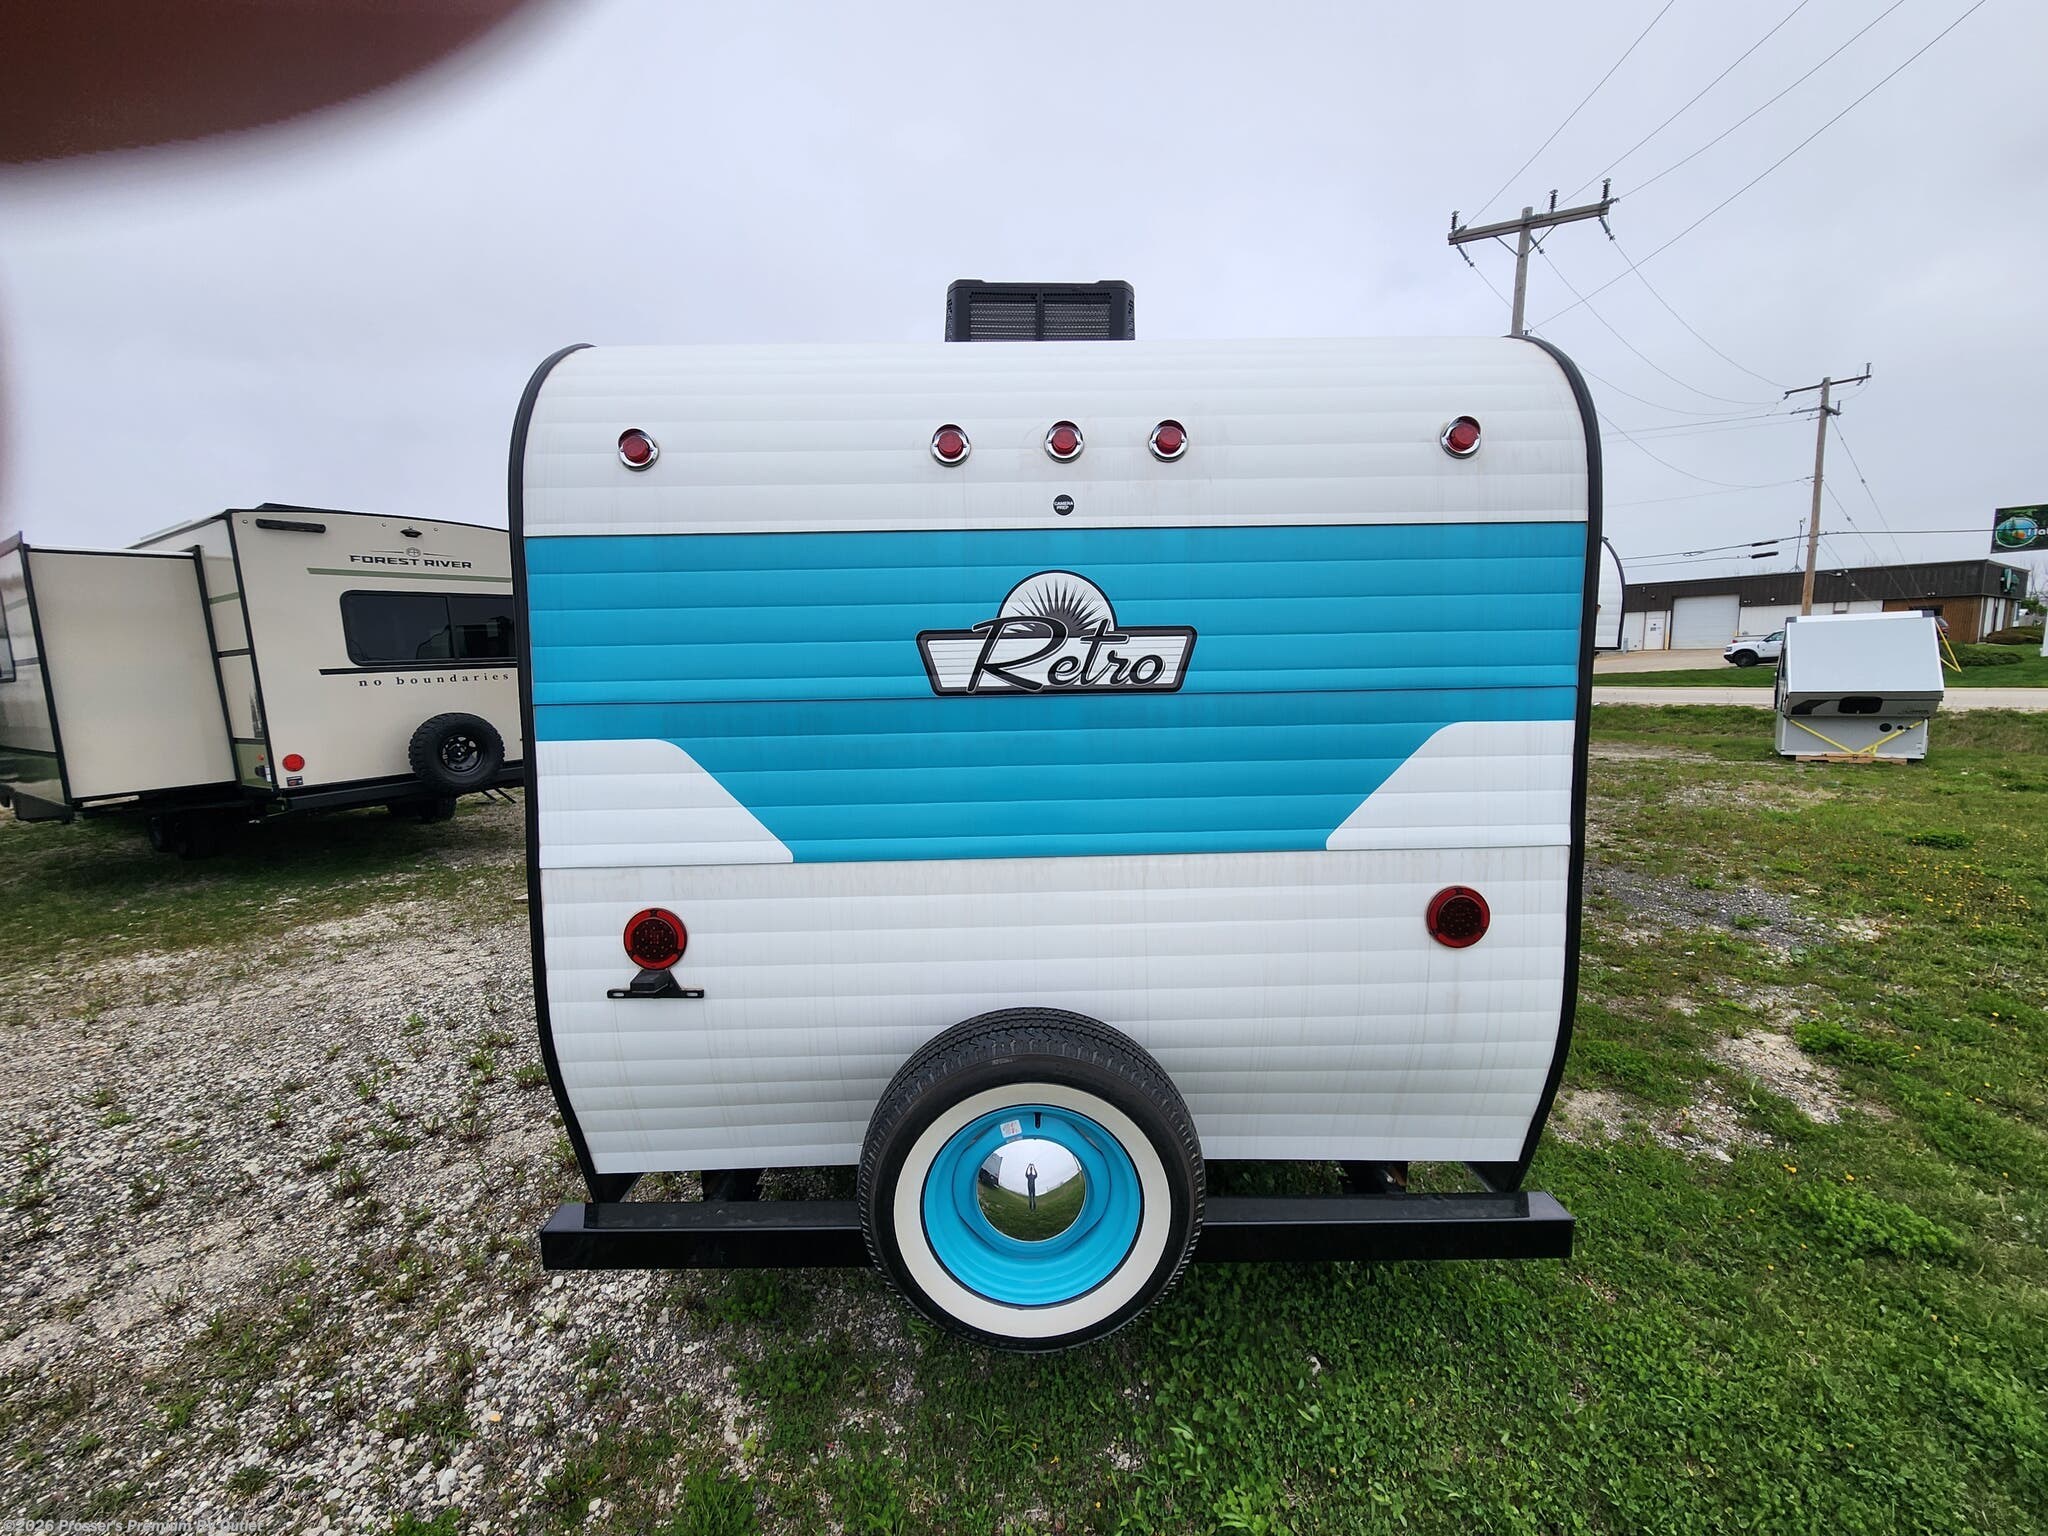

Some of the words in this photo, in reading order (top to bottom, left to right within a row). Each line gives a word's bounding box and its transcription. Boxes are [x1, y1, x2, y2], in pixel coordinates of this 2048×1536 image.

[350, 555, 419, 566] FOREST
[424, 559, 472, 569] RIVER
[966, 615, 1166, 693] Retro
[359, 678, 382, 687] no
[395, 672, 509, 686] boundaries
